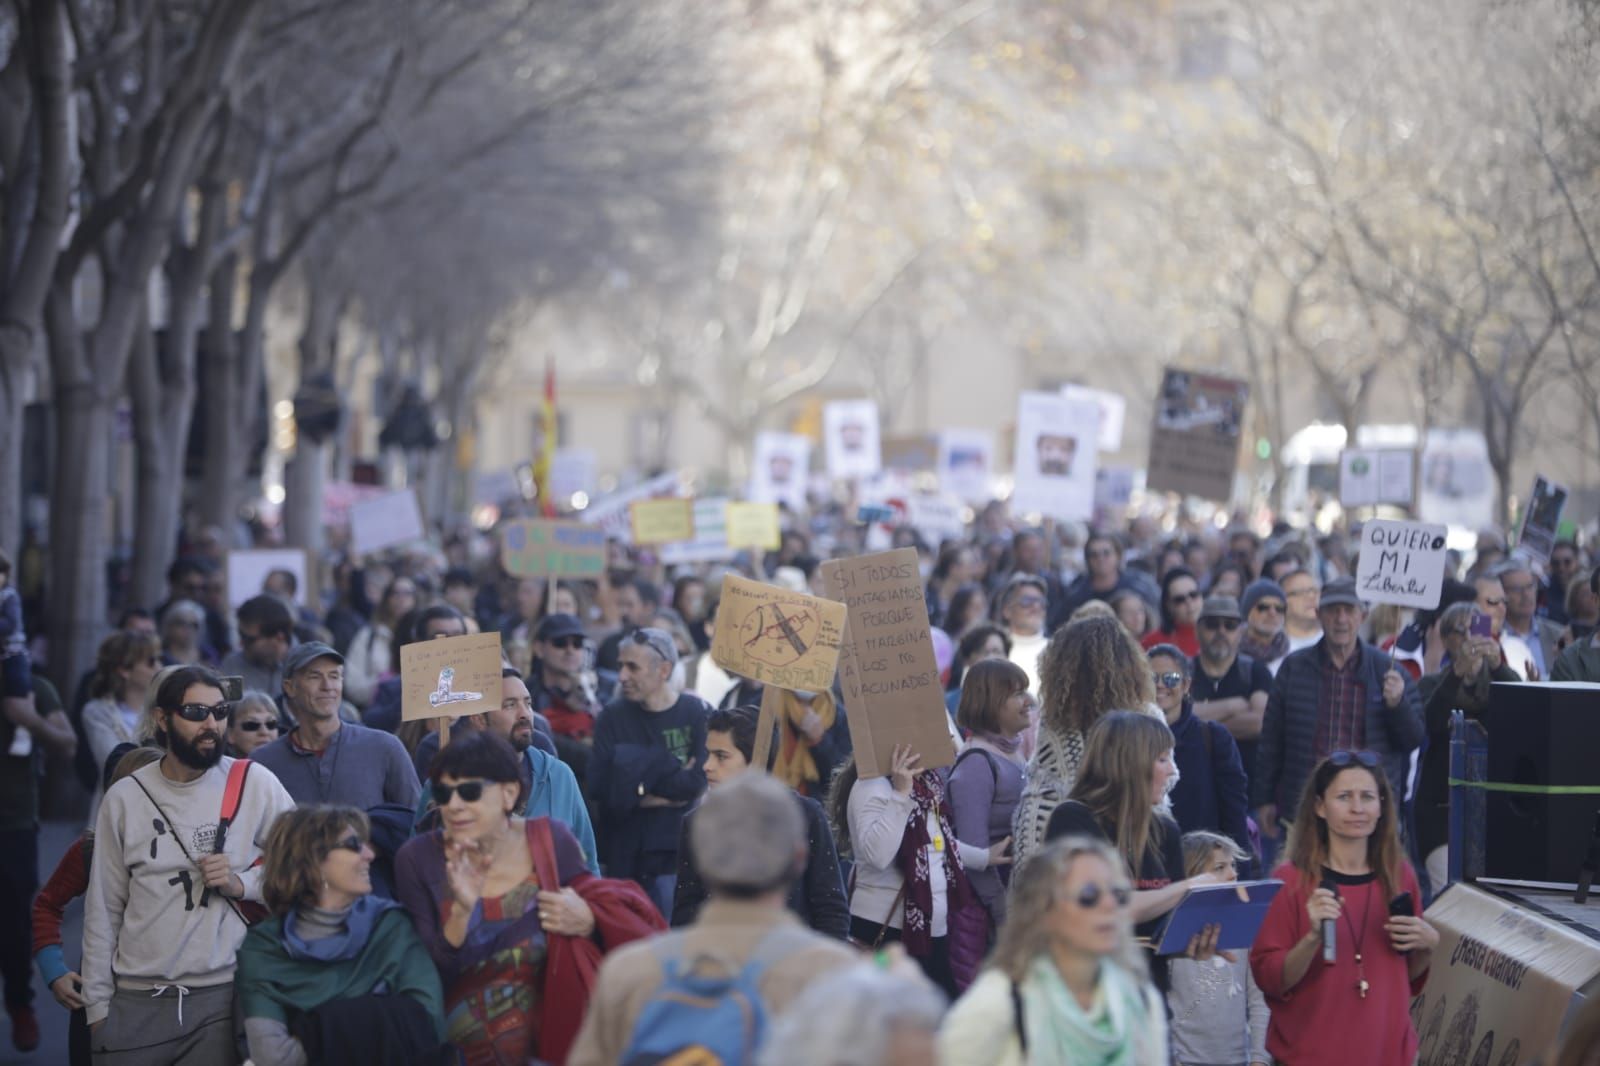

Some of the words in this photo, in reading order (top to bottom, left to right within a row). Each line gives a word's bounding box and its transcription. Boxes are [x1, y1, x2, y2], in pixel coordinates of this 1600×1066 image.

[1371, 526, 1445, 551] QUIERO
[1379, 549, 1410, 576] MI
[833, 568, 856, 590] SI
[861, 563, 912, 583] TODOS
[861, 606, 914, 629] PORQUE
[866, 629, 929, 649] MARGINA
[845, 664, 855, 677] A
[862, 658, 888, 672] LOS
